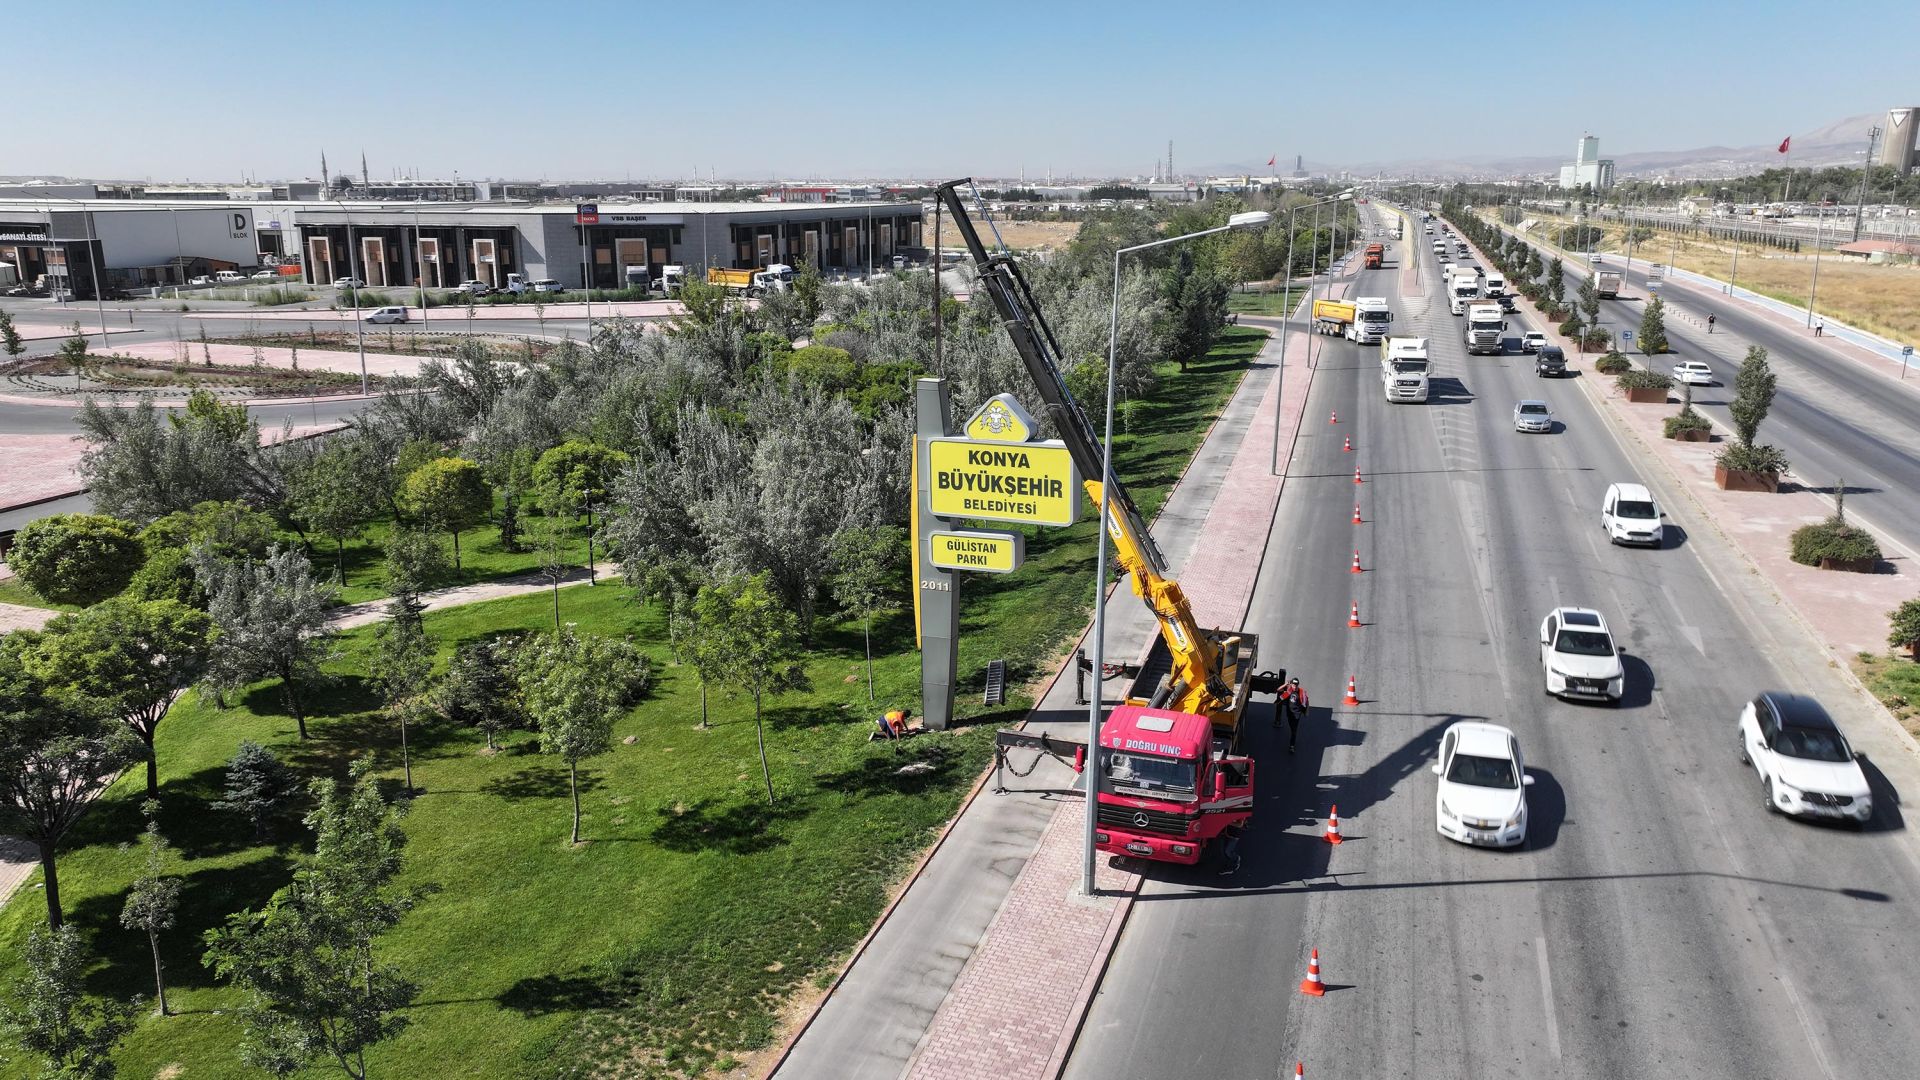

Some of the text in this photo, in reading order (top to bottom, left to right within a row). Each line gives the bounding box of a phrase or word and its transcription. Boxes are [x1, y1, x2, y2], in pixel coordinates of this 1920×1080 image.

[234, 213, 246, 230] D
[27, 231, 47, 242] SİTESİ
[968, 450, 1030, 469] KONYA
[938, 468, 1063, 498] BÜYÜKŞEHİR
[964, 498, 1037, 515] BELEDİYESİ
[947, 539, 997, 553] GÜLİSTAN
[957, 554, 987, 565] PARKI
[921, 580, 950, 592] 2011
[1125, 739, 1157, 752] DOĞRU
